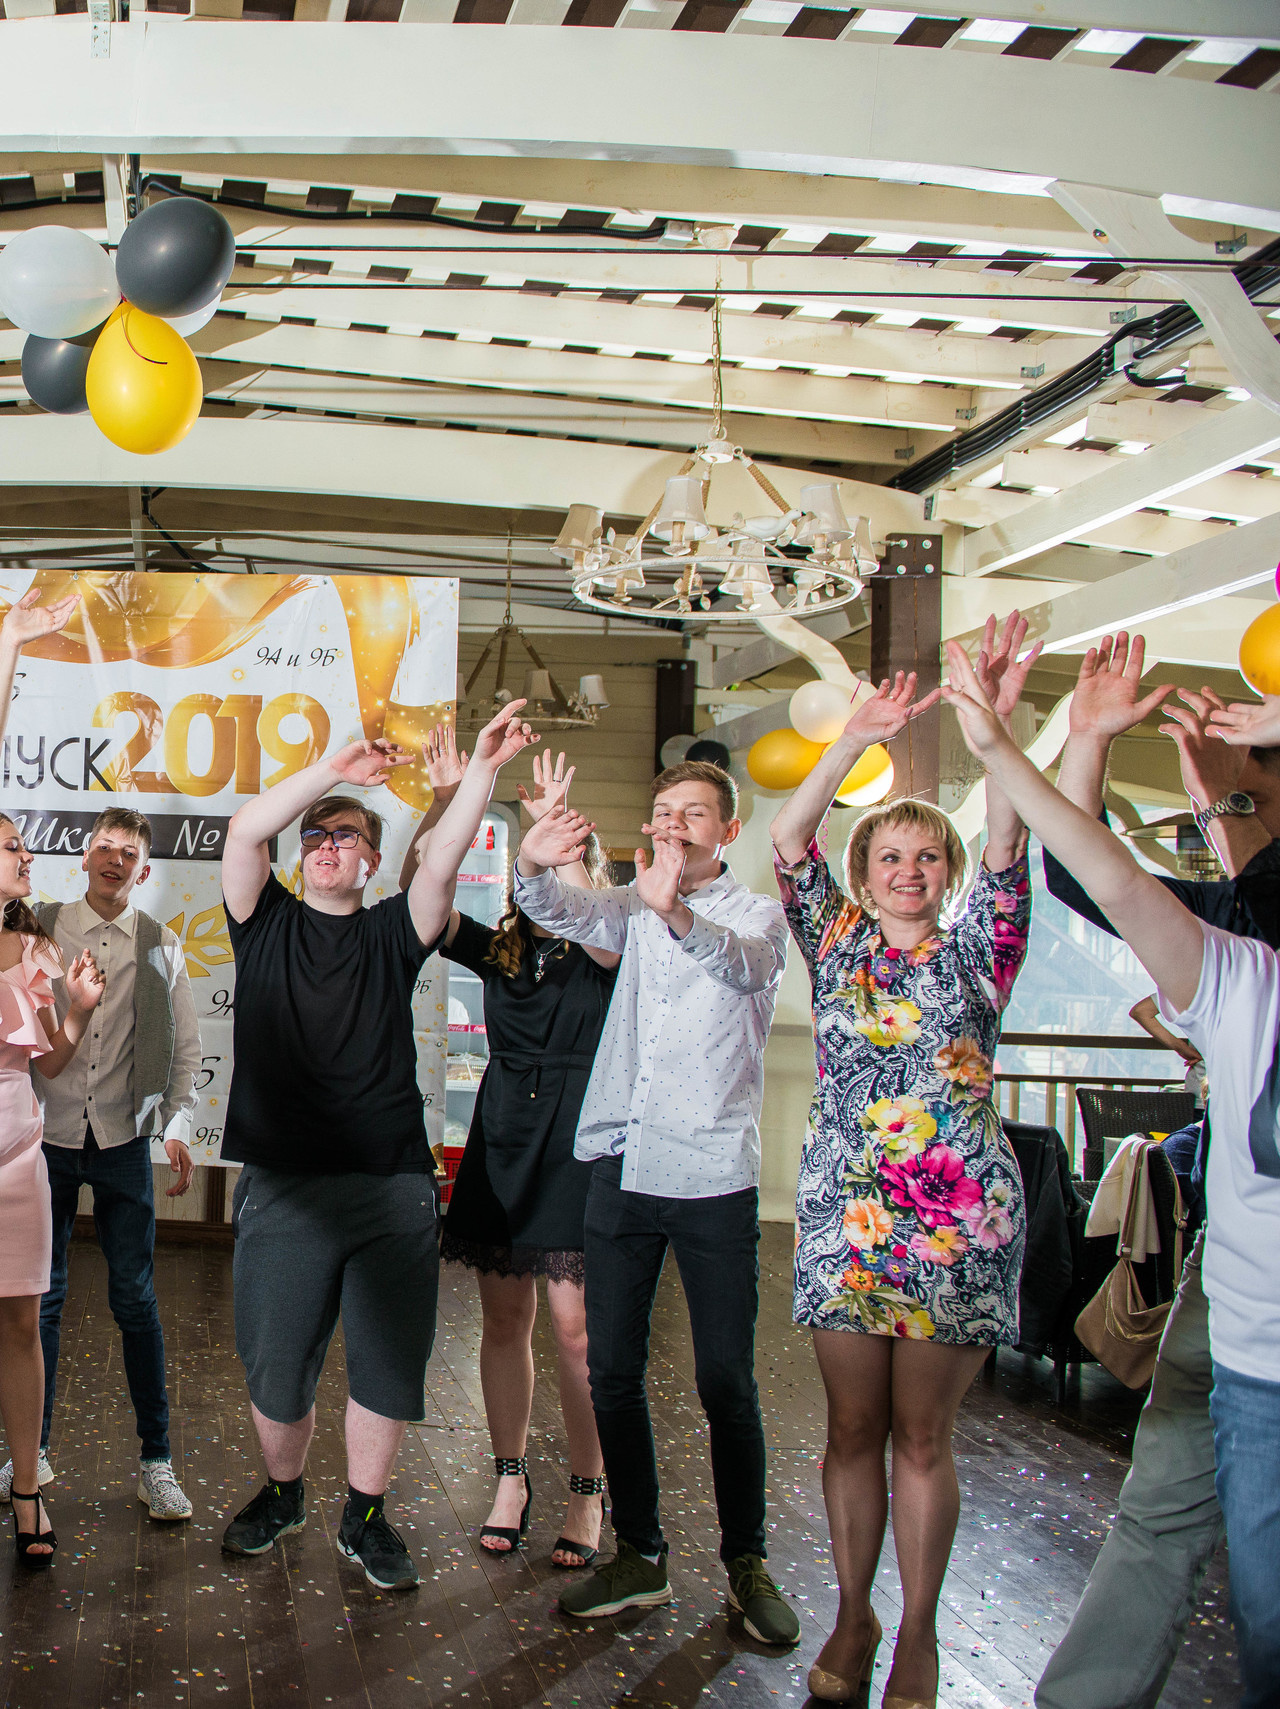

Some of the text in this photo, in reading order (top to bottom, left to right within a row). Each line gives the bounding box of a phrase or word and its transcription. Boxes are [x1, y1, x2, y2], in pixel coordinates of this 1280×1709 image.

[253, 646, 338, 667] 9А и 9Б
[91, 691, 331, 797] 2019
[193, 1127, 222, 1146] 9Б
